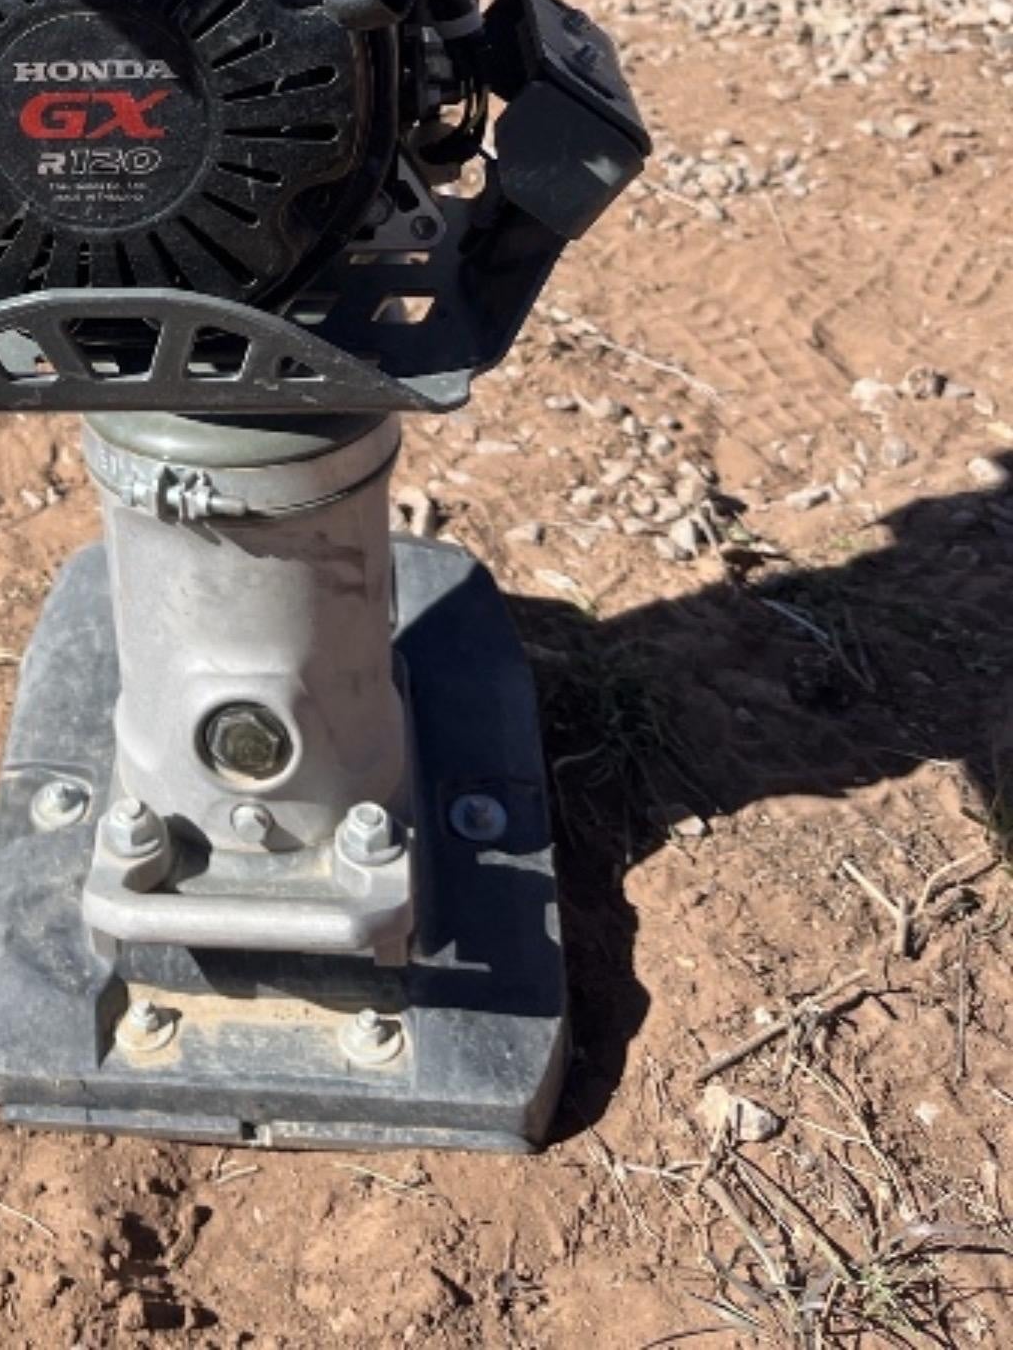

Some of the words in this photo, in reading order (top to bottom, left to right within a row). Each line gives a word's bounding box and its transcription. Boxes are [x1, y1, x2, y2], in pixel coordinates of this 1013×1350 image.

[13, 58, 180, 82] HONDA
[19, 90, 172, 139] GX
[37, 146, 163, 176] R120
